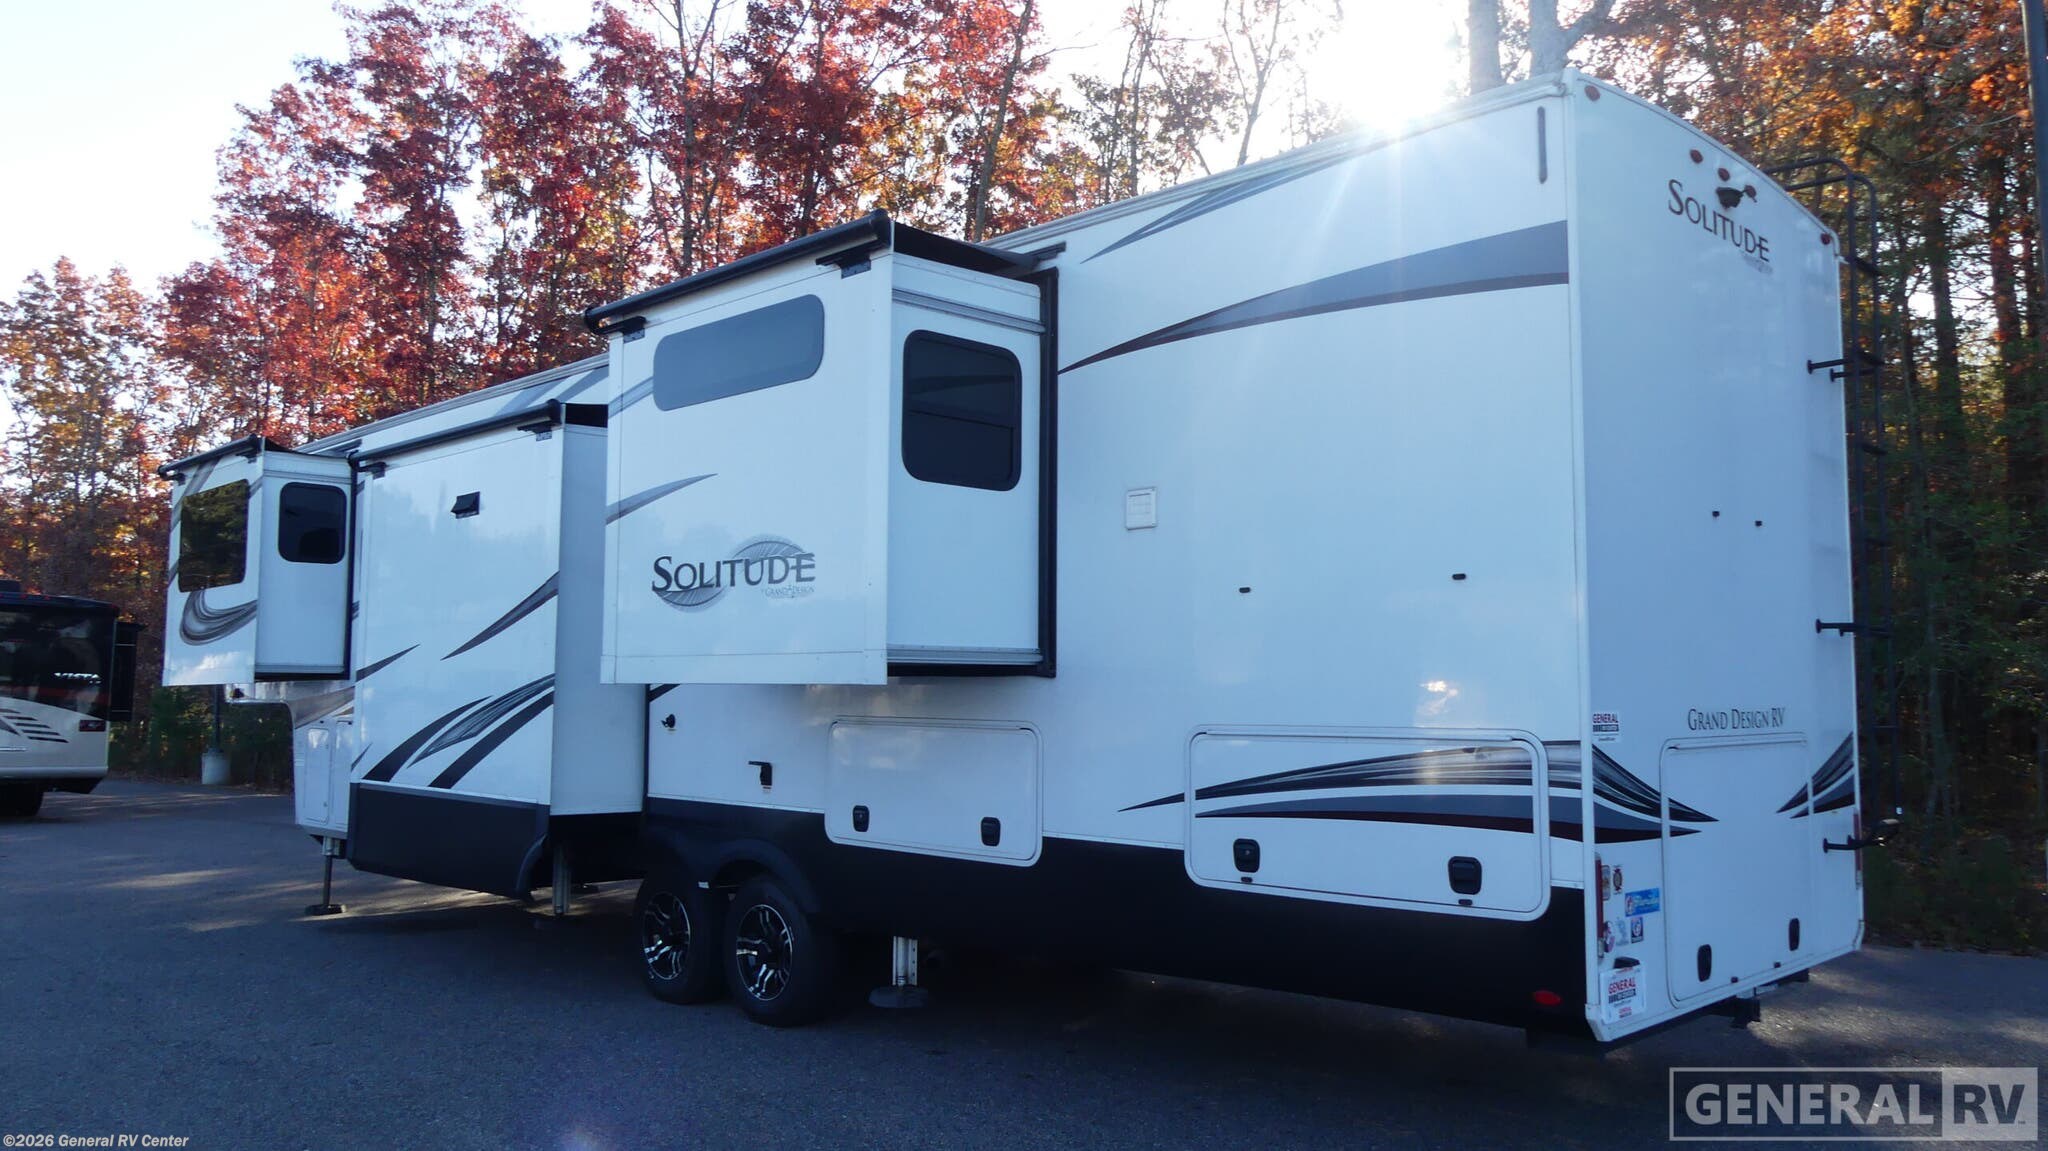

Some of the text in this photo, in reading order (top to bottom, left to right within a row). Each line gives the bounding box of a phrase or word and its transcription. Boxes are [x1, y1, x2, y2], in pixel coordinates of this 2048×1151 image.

[1668, 179, 1770, 263] SOLITUDE
[652, 552, 816, 592] SOLITUDE
[1592, 713, 1619, 724] GENERAL
[1687, 707, 1786, 731] GRAND DESIGN RV
[1608, 977, 1636, 994] GENERAL
